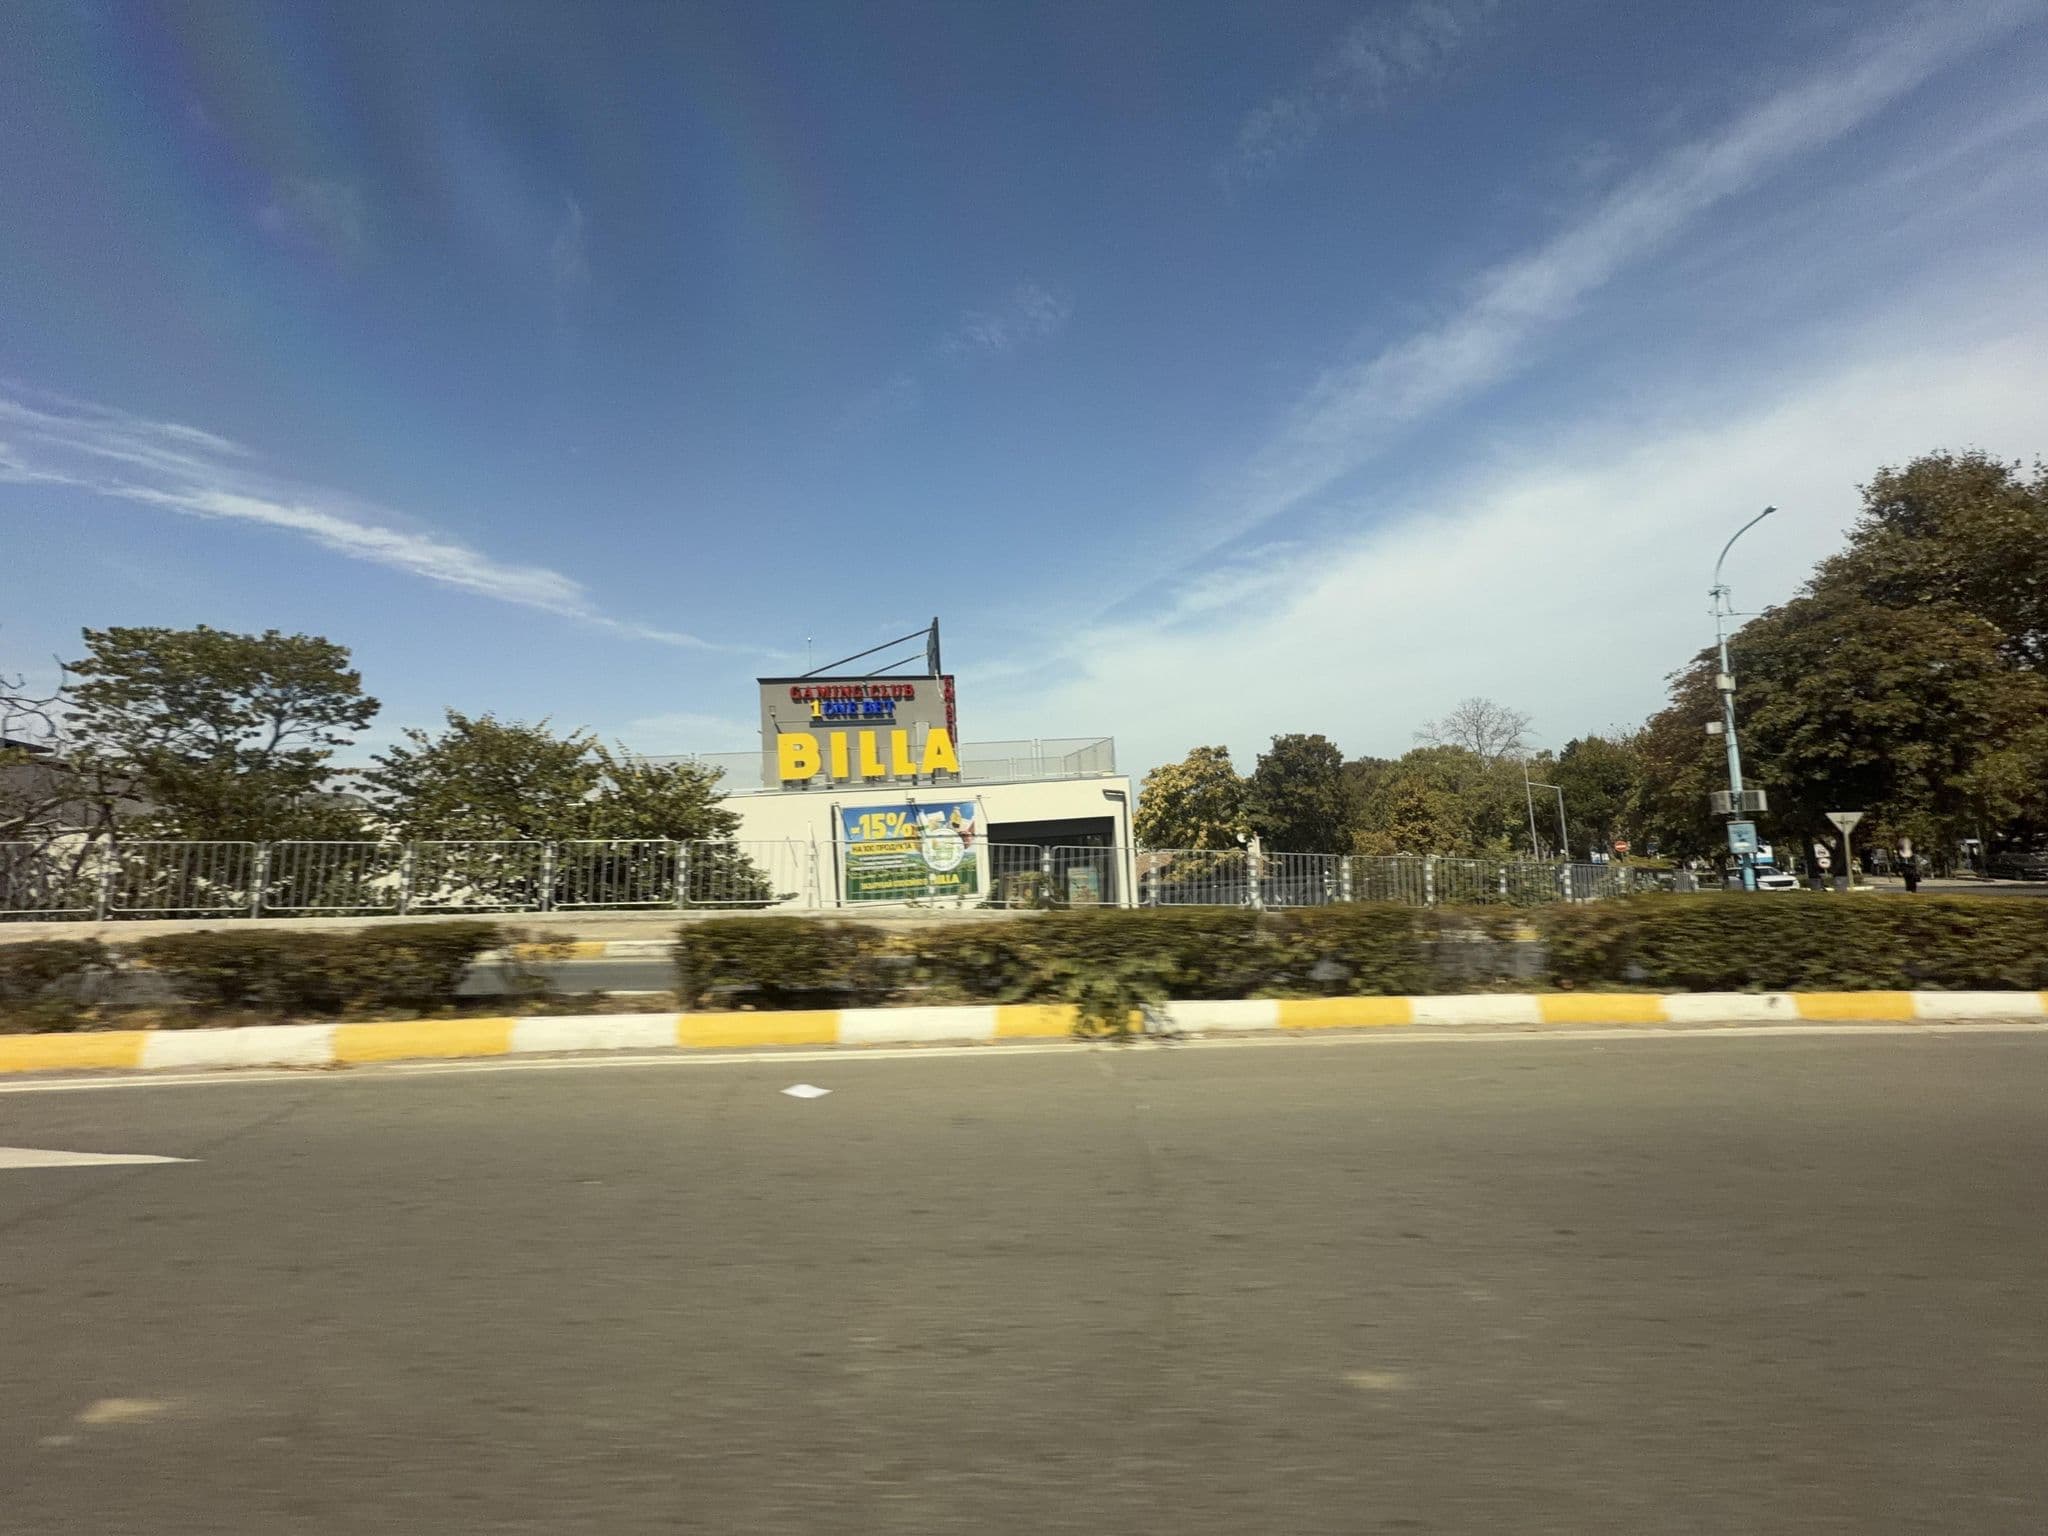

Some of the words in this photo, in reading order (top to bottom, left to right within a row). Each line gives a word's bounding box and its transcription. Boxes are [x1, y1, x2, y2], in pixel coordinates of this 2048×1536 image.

[790, 684, 863, 699] GAMING
[869, 683, 915, 698] CLUB
[810, 699, 821, 717] 1
[777, 728, 960, 780] BILLA
[850, 812, 914, 840] -15%
